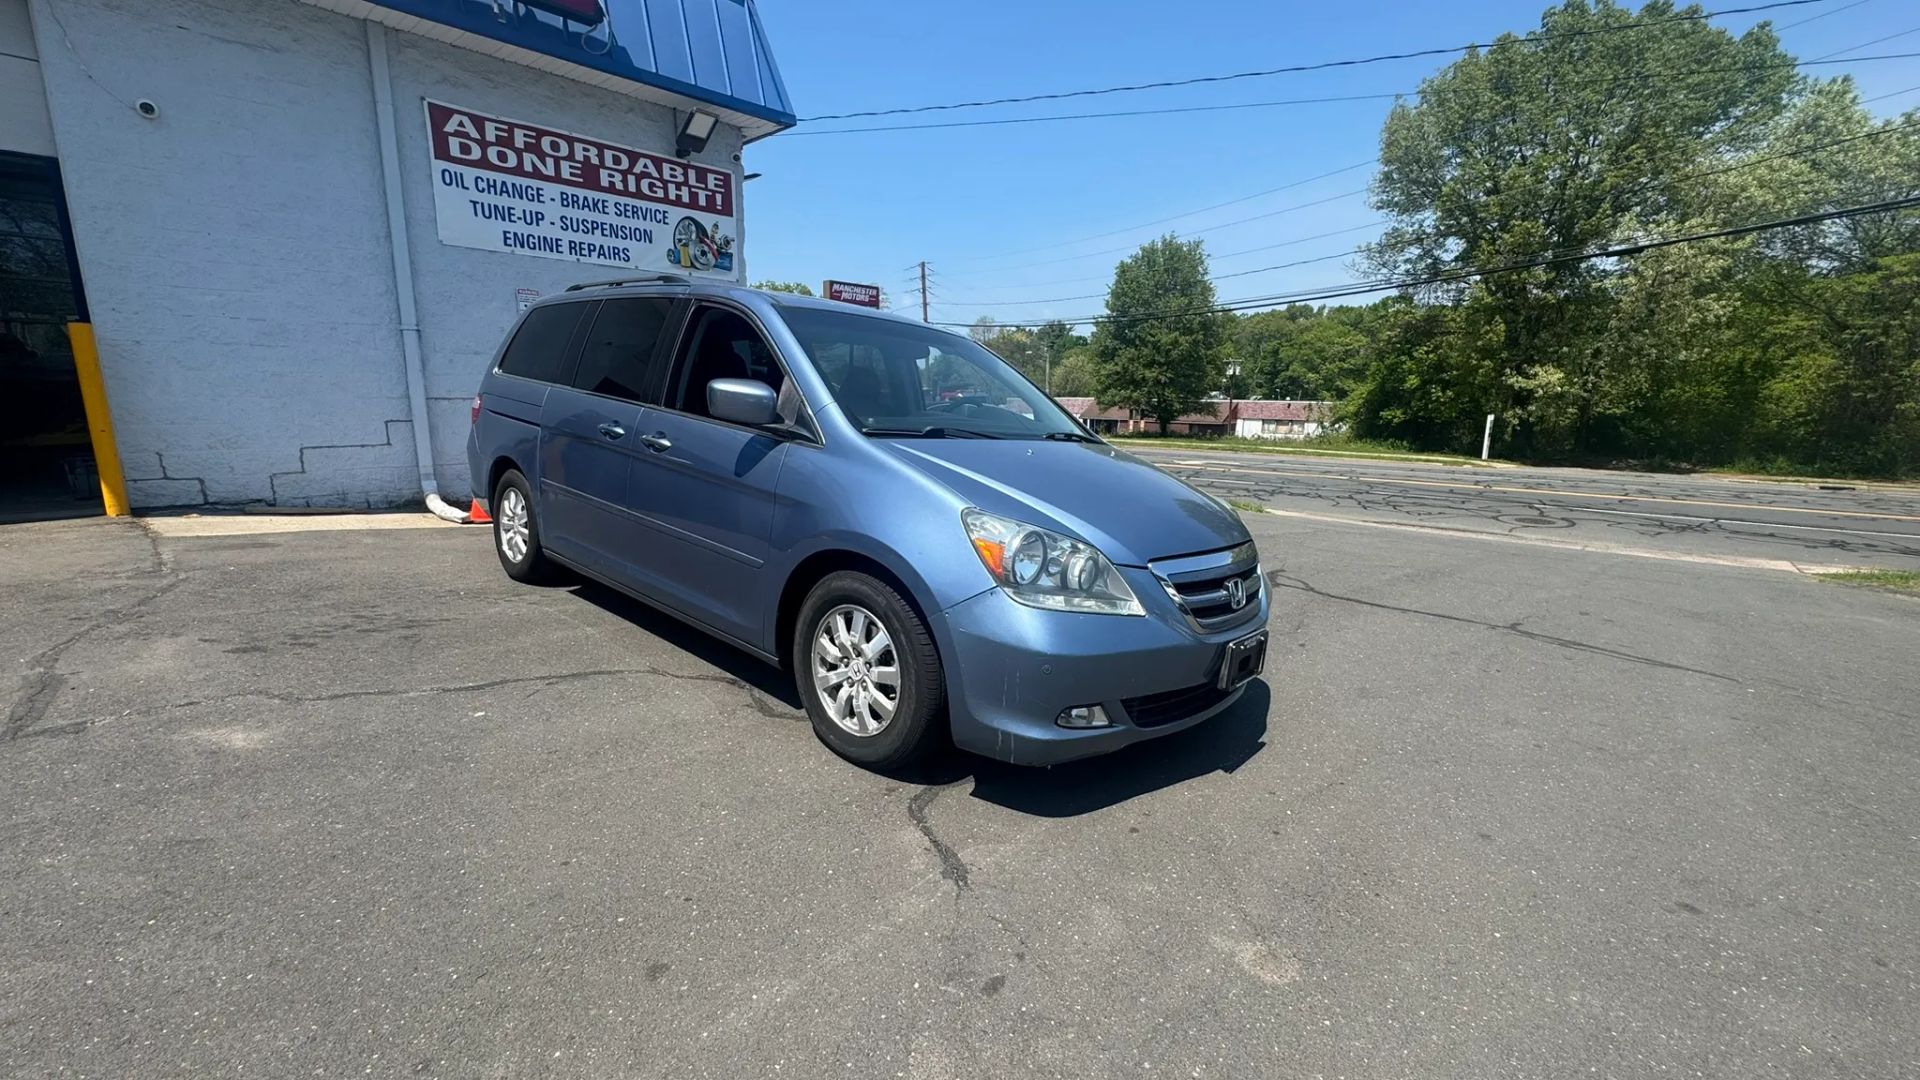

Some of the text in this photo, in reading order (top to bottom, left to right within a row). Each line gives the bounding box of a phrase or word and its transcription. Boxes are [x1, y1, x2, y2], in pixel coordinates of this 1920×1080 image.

[443, 113, 725, 193] AFFORDABLE
[448, 135, 723, 210] DONE RIGHT!
[441, 168, 469, 192] OIL
[474, 175, 545, 204] CHANGE
[560, 191, 609, 216] BRAKE
[614, 202, 669, 226] SERVICE
[469, 200, 545, 227] TUNE-UP
[560, 216, 653, 245] SUSPENSION
[503, 230, 631, 263] ENGINE REPAIRS
[832, 283, 877, 296] MANCHESTER
[841, 291, 870, 302] MOTORS
